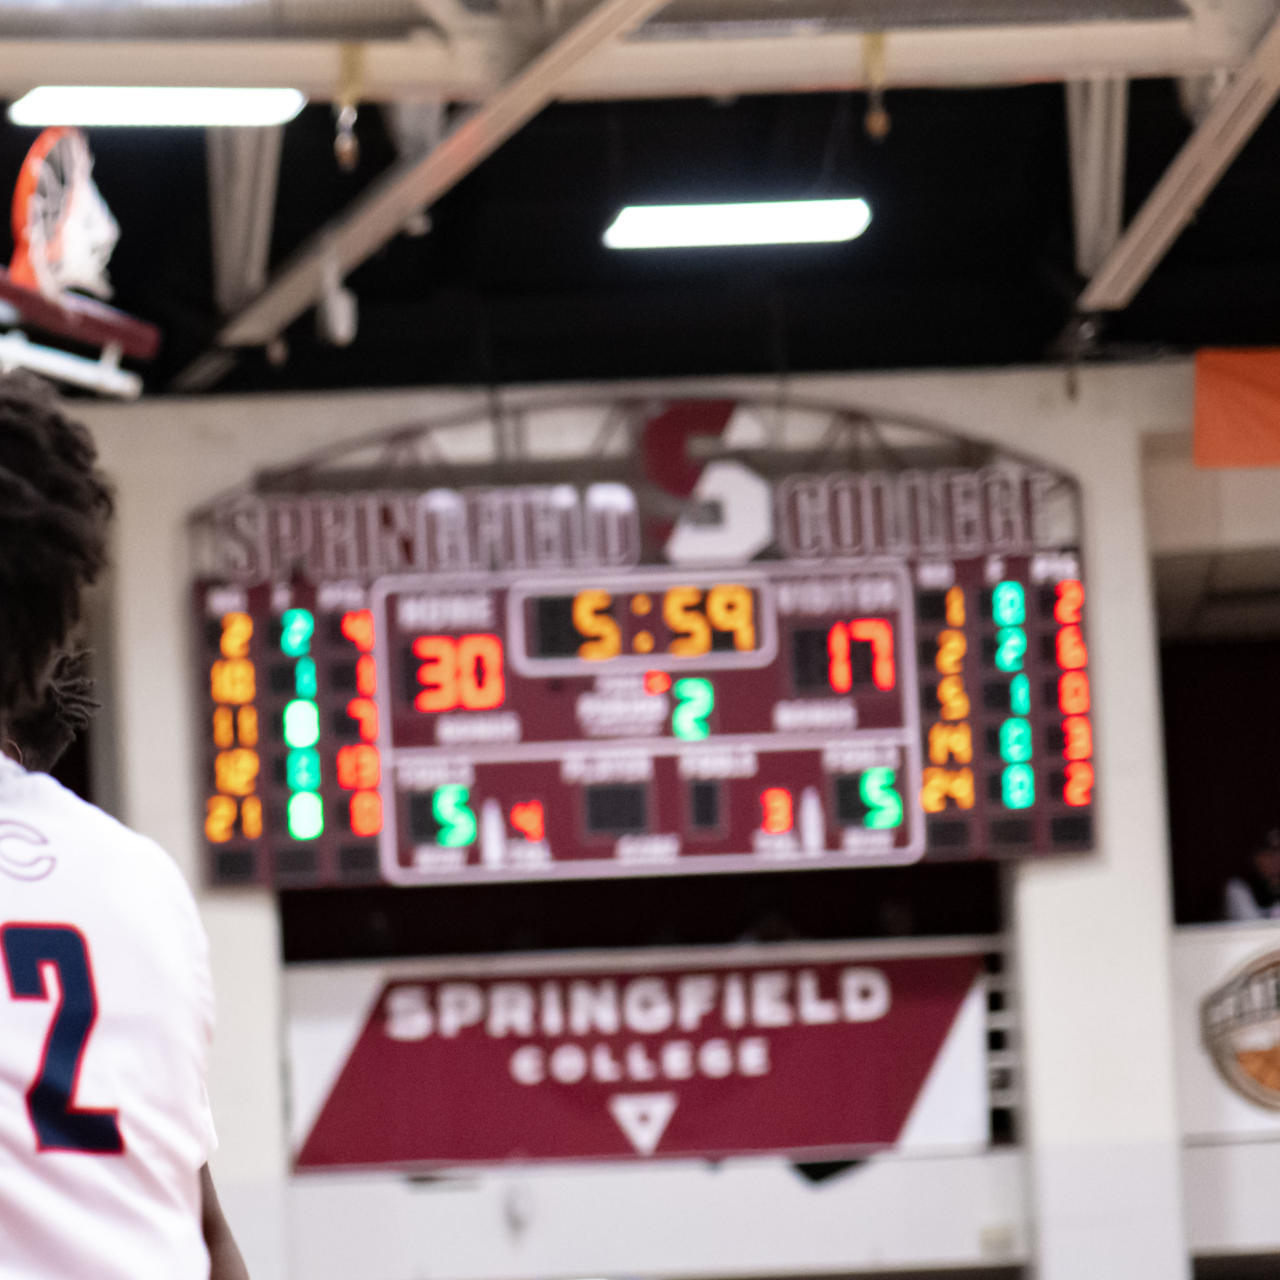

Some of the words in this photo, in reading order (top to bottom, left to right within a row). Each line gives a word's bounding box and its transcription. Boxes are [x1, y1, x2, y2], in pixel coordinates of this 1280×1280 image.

[572, 584, 756, 662] 5:59
[827, 618, 896, 694] 17
[412, 633, 506, 714] 30
[672, 677, 715, 742] 2
[432, 783, 477, 848] 5
[858, 766, 904, 830] 5
[385, 966, 892, 1041] SPRINGFIELD
[509, 1036, 771, 1086] COLLEGE
